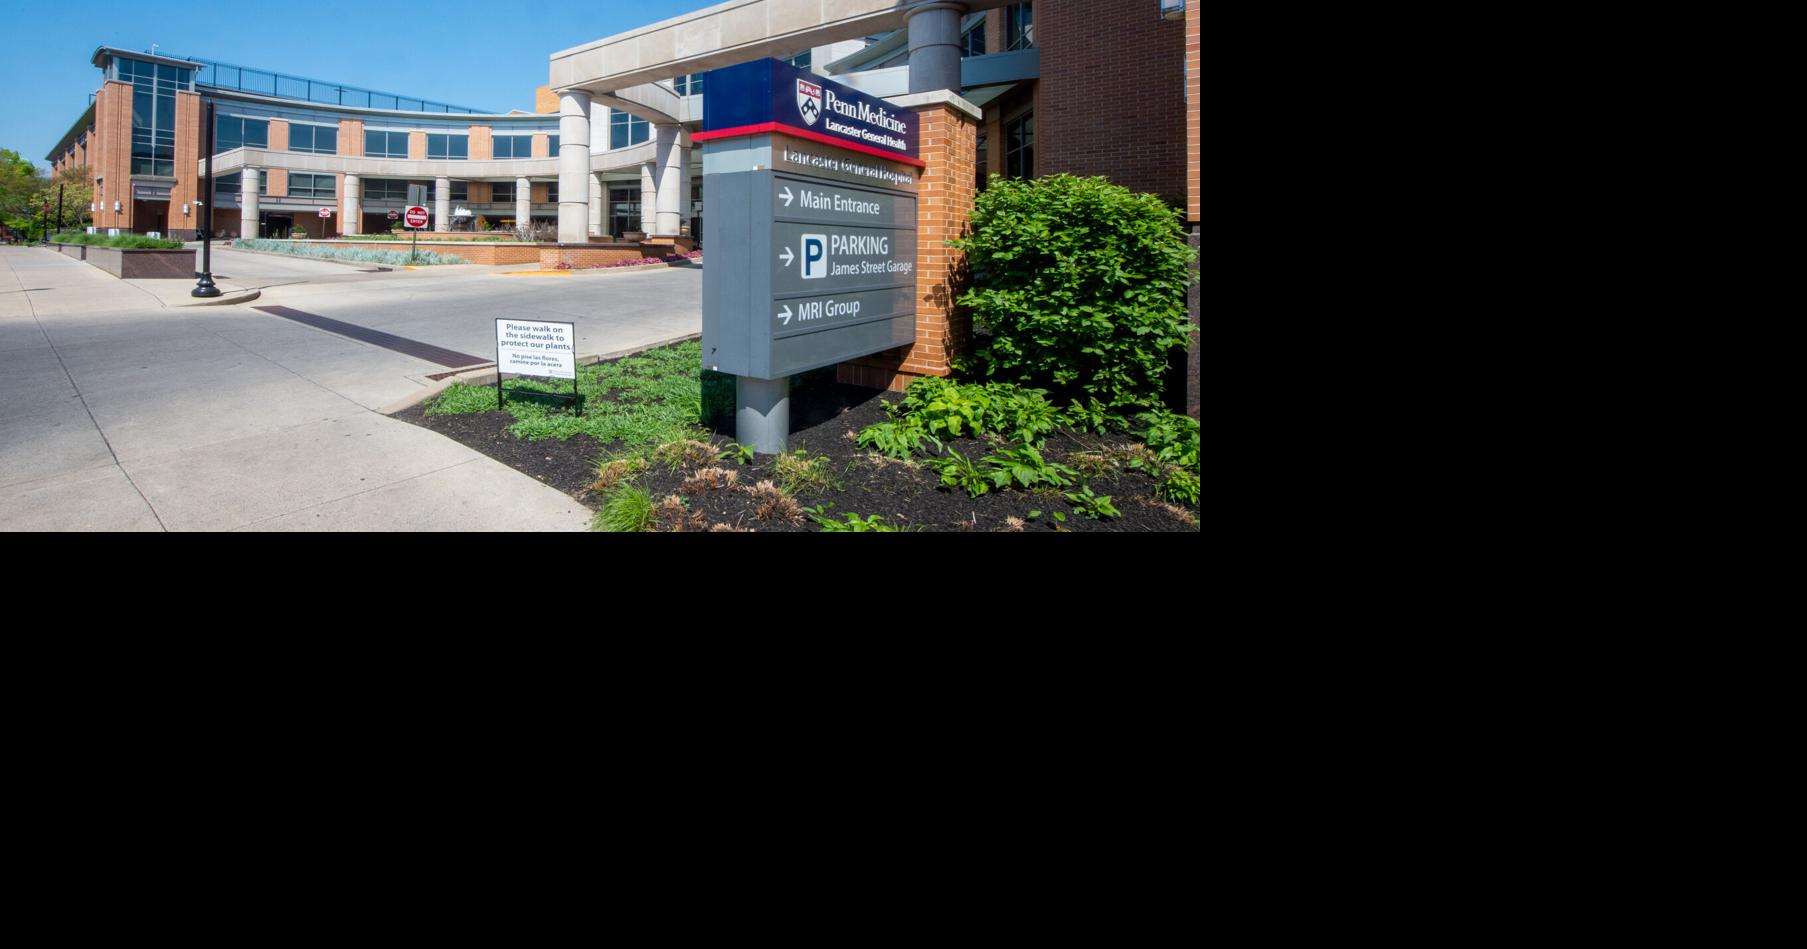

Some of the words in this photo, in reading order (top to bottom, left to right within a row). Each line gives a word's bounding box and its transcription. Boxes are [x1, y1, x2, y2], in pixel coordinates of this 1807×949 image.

[825, 89, 856, 118] Penn
[858, 101, 907, 134] Medicine
[825, 118, 861, 138] Lancaster
[862, 129, 886, 144] General
[886, 136, 906, 150] Health
[783, 145, 838, 171] Lancaster
[841, 159, 878, 178] General
[879, 164, 912, 185] Hospital
[800, 190, 831, 210] Main
[834, 194, 880, 215] Entrance
[831, 234, 888, 255] PARKING
[805, 238, 823, 276] P
[830, 261, 860, 276] James
[861, 260, 886, 274] Street
[886, 260, 912, 275] Garage
[798, 301, 823, 321] MRI
[825, 300, 860, 317] Group
[506, 323, 531, 331] Please
[520, 333, 554, 341] sidewalk
[501, 340, 529, 348] protect
